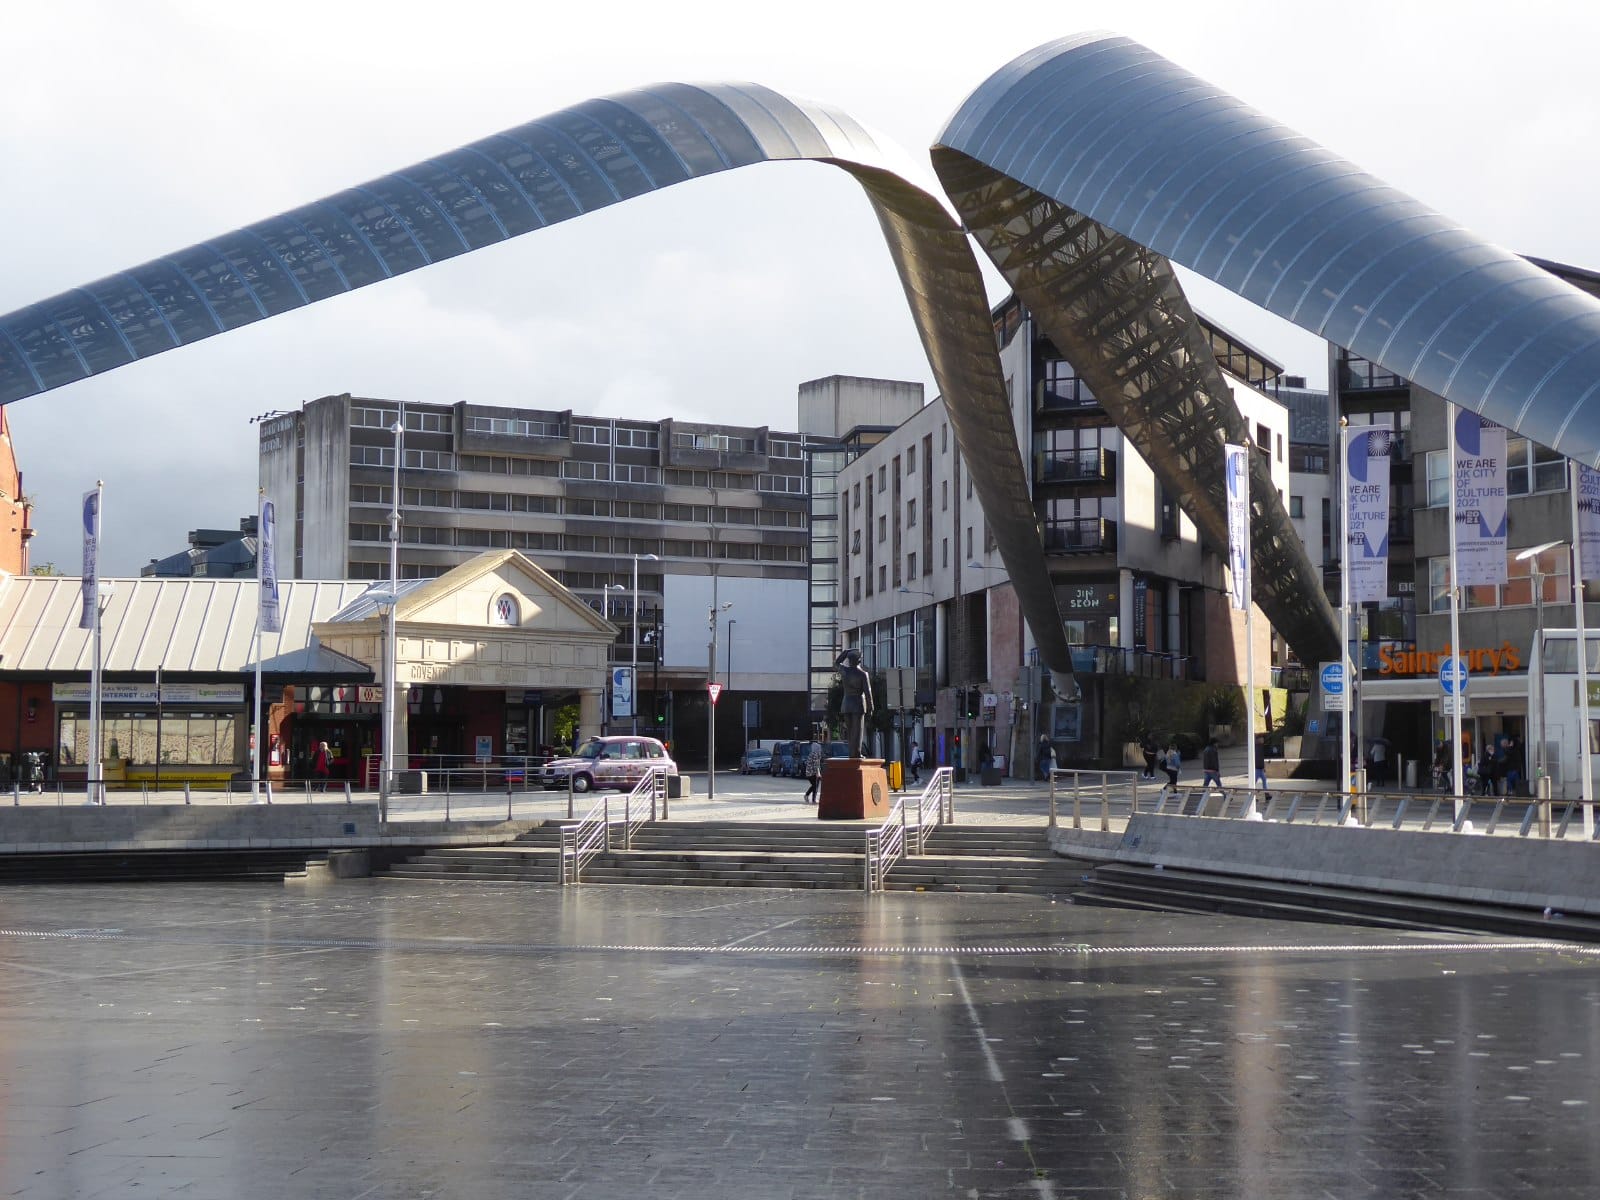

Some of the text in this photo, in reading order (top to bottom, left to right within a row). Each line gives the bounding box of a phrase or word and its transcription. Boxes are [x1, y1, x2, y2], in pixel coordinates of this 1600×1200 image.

[1457, 459, 1496, 468] WE ARE
[1456, 469, 1497, 479] UK CITY
[1456, 479, 1470, 488] OF
[1363, 485, 1380, 494] ARE
[1456, 488, 1504, 498] CULTURE
[1360, 494, 1381, 503] CITY
[1457, 498, 1480, 508] 2021
[1070, 599, 1099, 608] SEON
[1378, 640, 1521, 676] Sainsury's
[411, 665, 451, 681] COVENTRY
